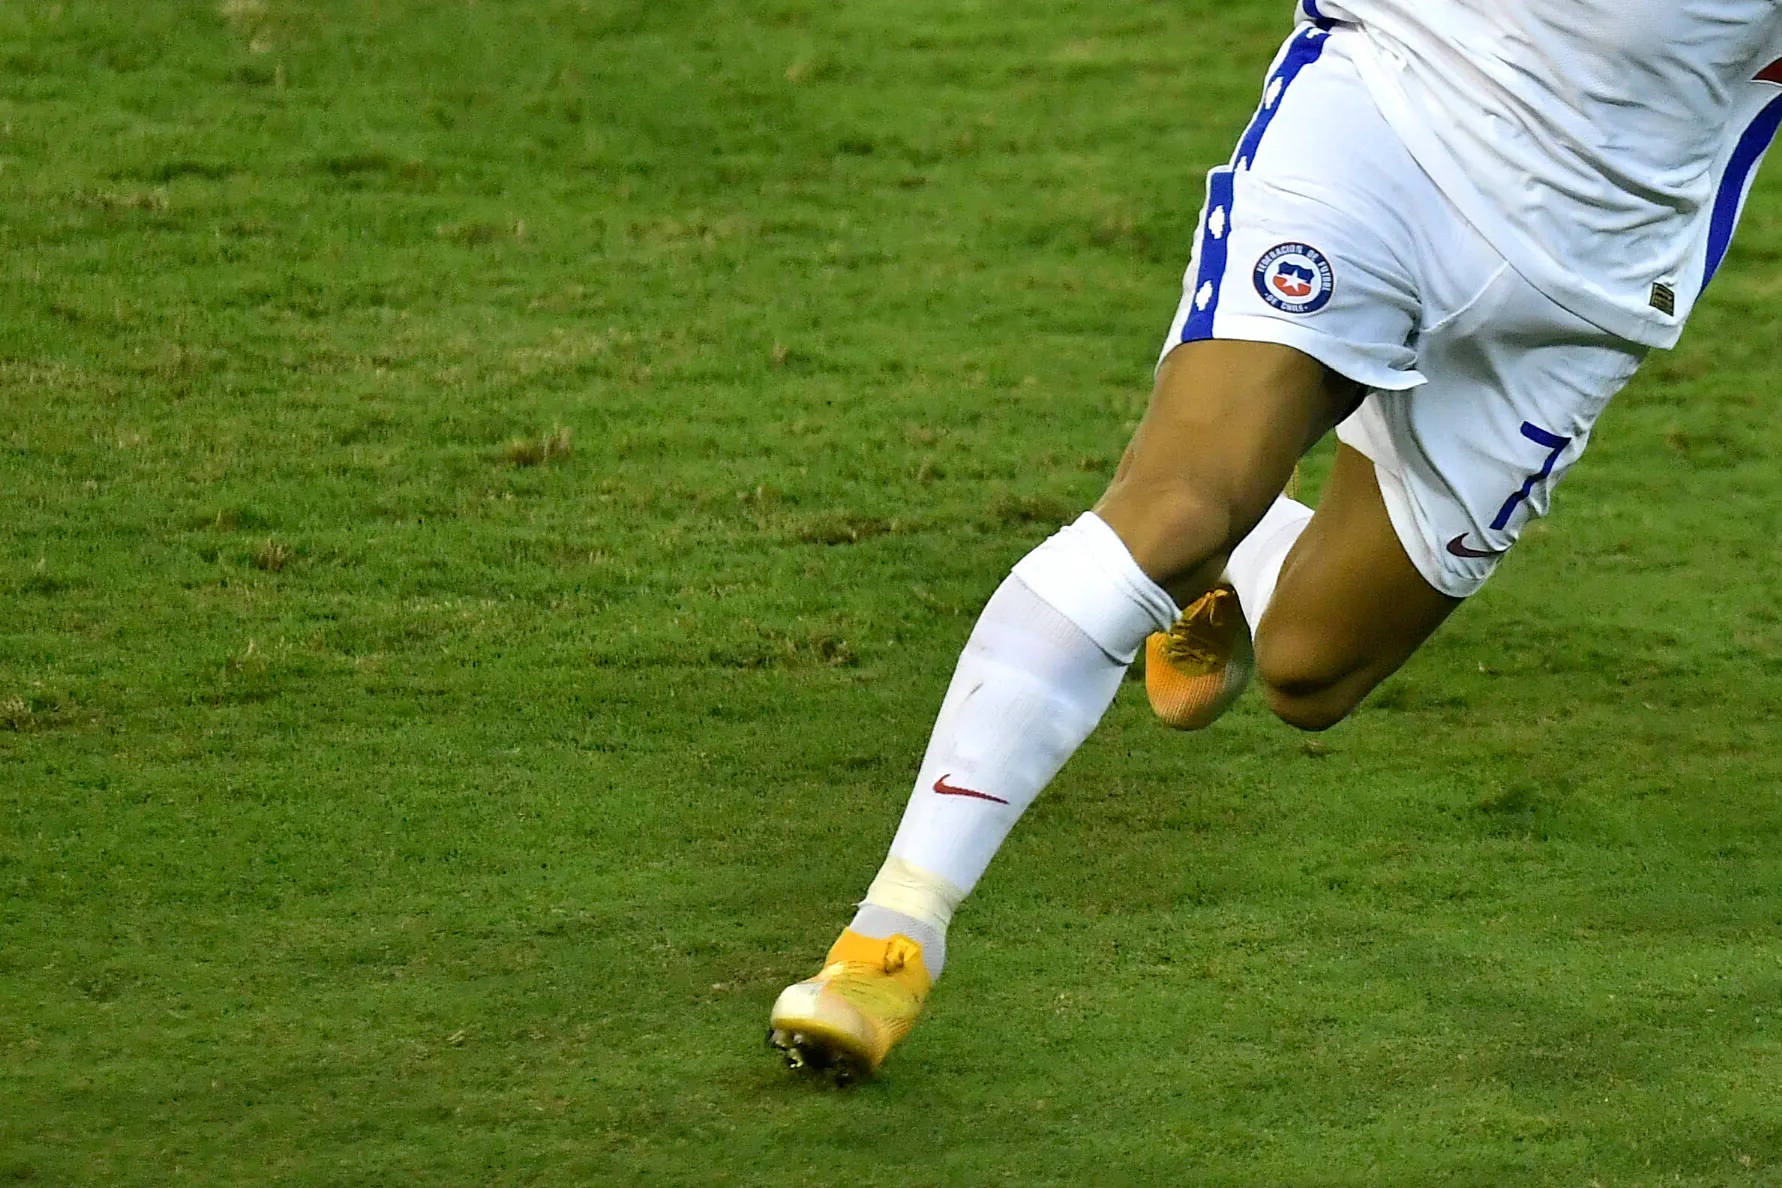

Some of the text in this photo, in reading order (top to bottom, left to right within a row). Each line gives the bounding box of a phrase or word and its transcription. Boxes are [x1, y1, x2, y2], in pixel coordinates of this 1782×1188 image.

[1256, 245, 1332, 291] FEDERACION DE FUTBOL
[1280, 302, 1305, 312] CHILE
[1489, 421, 1572, 530] 7
